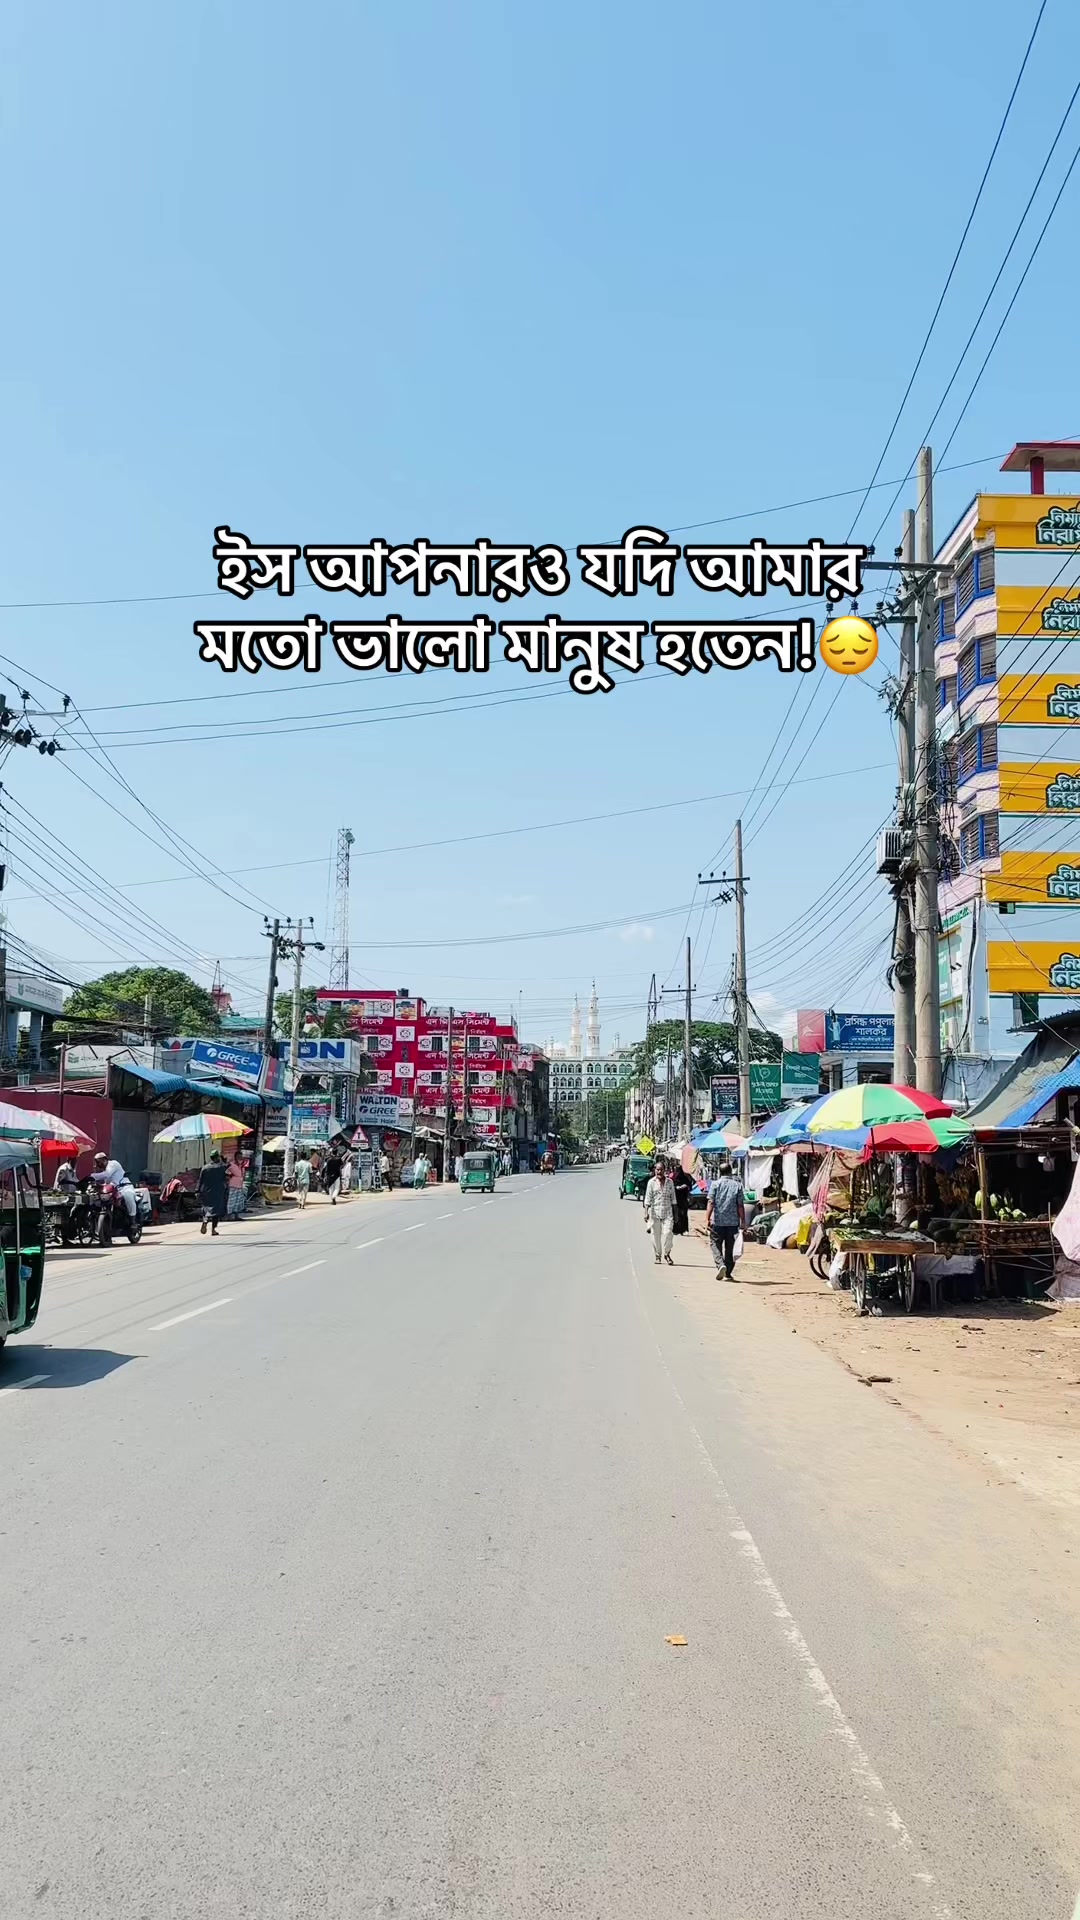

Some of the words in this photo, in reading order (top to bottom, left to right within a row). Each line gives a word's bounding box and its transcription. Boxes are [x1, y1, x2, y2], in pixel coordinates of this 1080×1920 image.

[217, 1050, 250, 1066] GREE
[359, 1095, 398, 1105] WALTON
[369, 1106, 397, 1115] GREE
